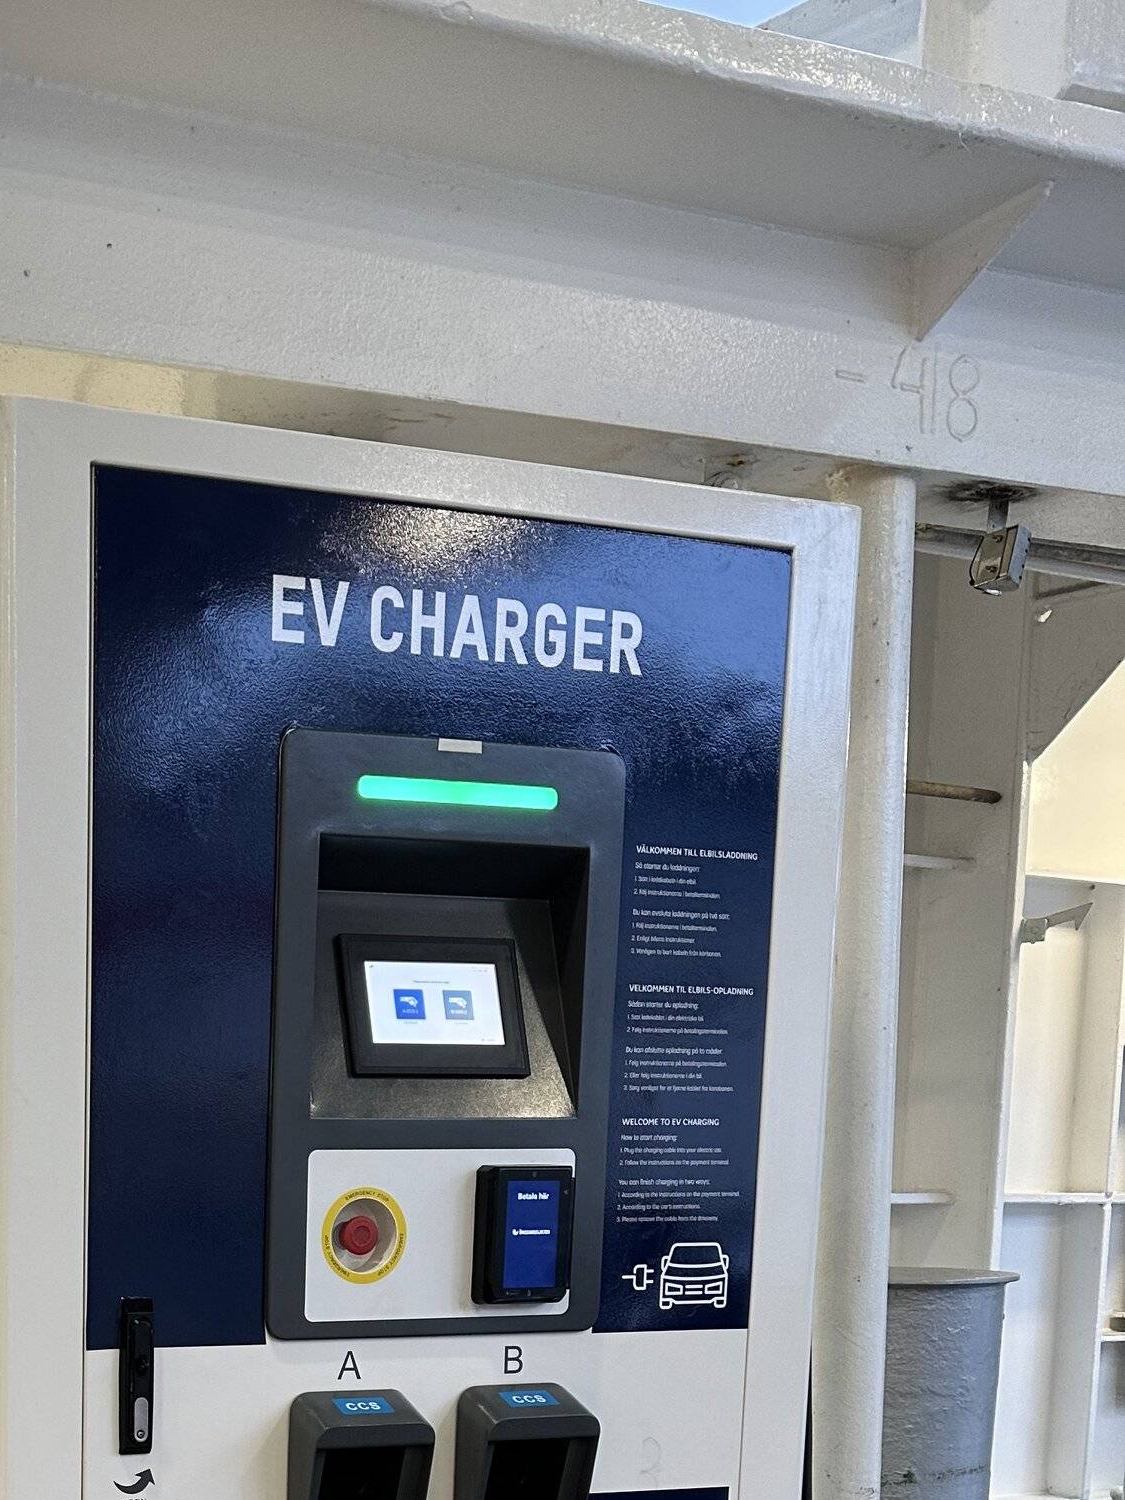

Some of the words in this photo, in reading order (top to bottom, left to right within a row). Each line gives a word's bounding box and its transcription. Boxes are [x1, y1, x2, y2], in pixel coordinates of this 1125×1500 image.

[271, 574, 350, 647] EV
[370, 585, 644, 676] CHARGER
[636, 844, 682, 856] VÄLKOMMEN
[684, 848, 698, 857] TILL
[699, 849, 758, 861] ELBILSLADDNING
[629, 984, 674, 993] VELKOMMEN
[676, 985, 687, 994] TIL
[688, 986, 754, 996] ELBILS-OPLADNING
[622, 1118, 659, 1126] WELCOME
[660, 1118, 671, 1126] TO
[672, 1118, 682, 1126] EV
[682, 1118, 720, 1126] CHARGING
[517, 1192, 538, 1201] Betala
[338, 1350, 361, 1381] A
[503, 1346, 524, 1374] B
[344, 1399, 382, 1413] CCS
[511, 1391, 547, 1406] CCS
